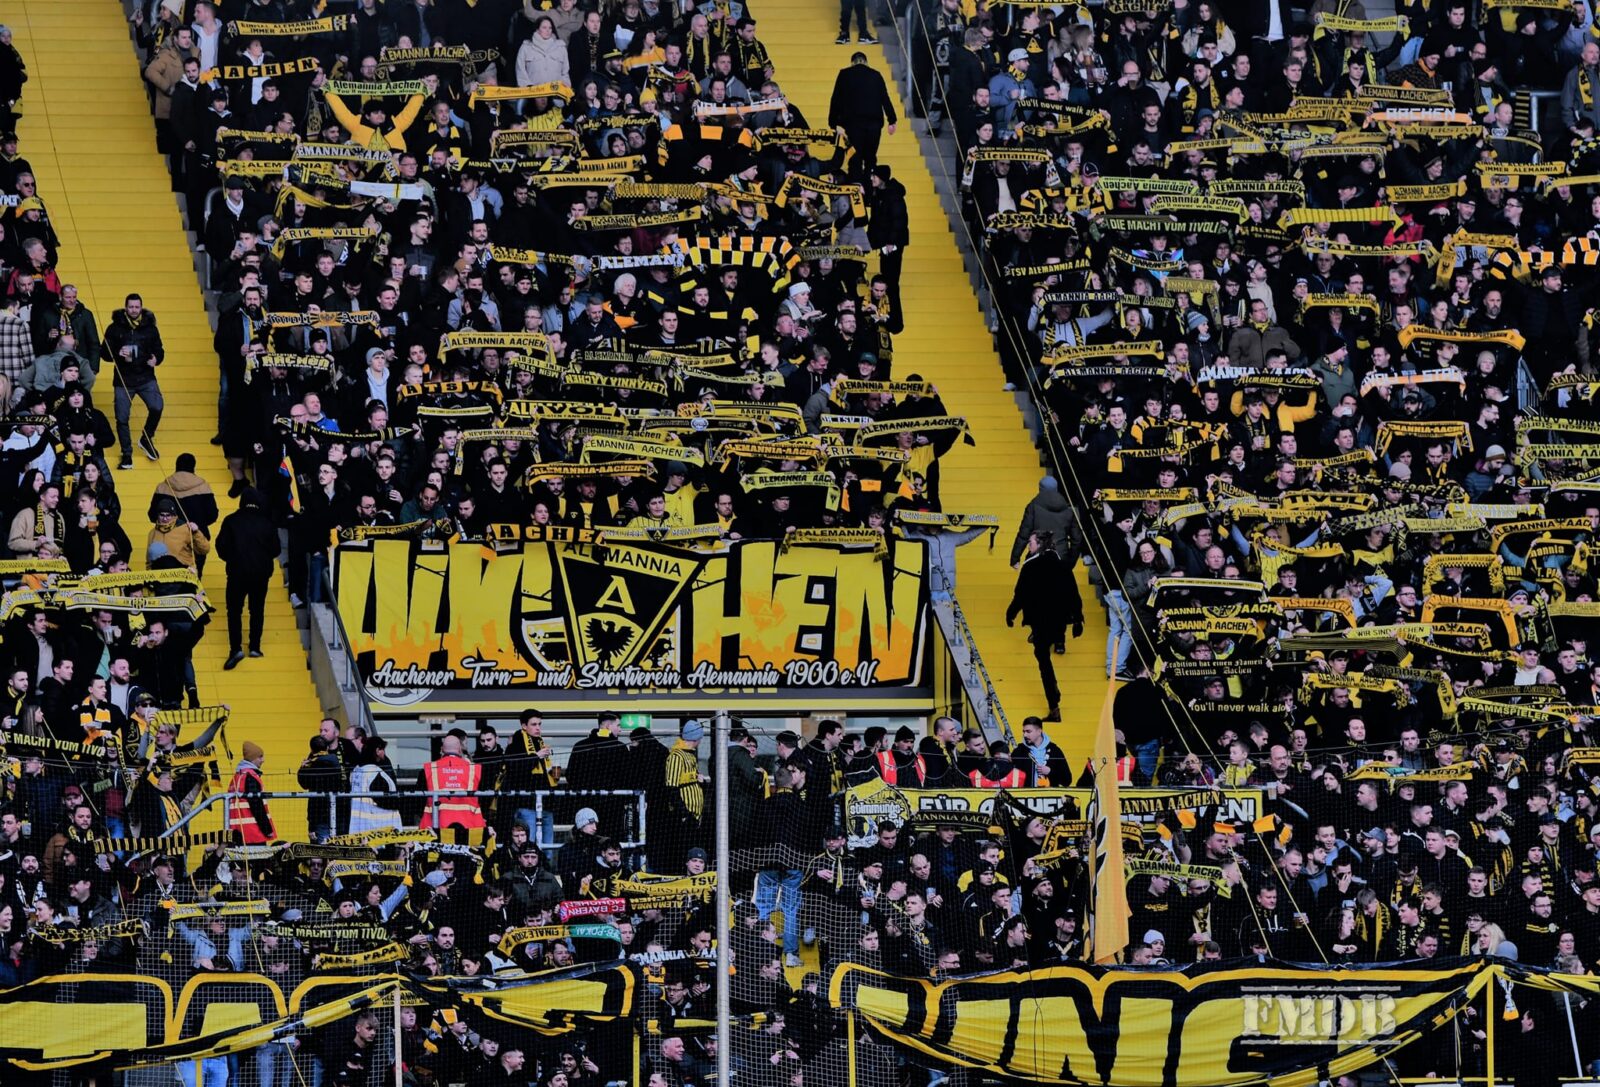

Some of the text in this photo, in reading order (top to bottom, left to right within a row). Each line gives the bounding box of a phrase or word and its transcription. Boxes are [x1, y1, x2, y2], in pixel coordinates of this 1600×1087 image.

[380, 47, 429, 61] LEMANNIA
[333, 79, 422, 92] Alemannia Aachen
[1359, 87, 1429, 101] ALEMANNIA AACHEN
[1040, 101, 1064, 112] never
[1065, 104, 1089, 116] walk
[297, 145, 352, 159] EMANNIA
[247, 161, 323, 171] ALEMNNIA
[1211, 182, 1268, 193] LEMANNIA
[1154, 196, 1241, 209] lemannia Aachen
[1109, 219, 1126, 230] DIE
[332, 227, 372, 238] WILLI
[1009, 266, 1026, 277] TSV
[1026, 262, 1071, 275] ALEMANNIA
[1043, 291, 1089, 302] LEMANNIA
[451, 337, 547, 349] ALEMANNIA AACHEN
[1057, 341, 1151, 358] EMANNIA AACHEN
[565, 372, 667, 396] LEMANNIA AACHEN
[840, 381, 924, 392] LEMANNIA AACHEN
[1550, 374, 1597, 389] LEMANNIA
[495, 429, 514, 437] WALK
[585, 438, 684, 457] EMANNIA AACHEN
[804, 529, 878, 538] ALEMANNIA
[1494, 520, 1555, 539] ALEMANNIA
[563, 544, 682, 577] ALMANNIA
[1165, 607, 1203, 616] MANNIA
[1214, 620, 1248, 631] AACHEN
[1356, 628, 1392, 637] WIR SIND
[1167, 659, 1198, 668] radition
[372, 656, 879, 689] Aachener Turn- und Sportverein Alemannia 1900 e.V.
[1223, 666, 1252, 675] Aachen
[1217, 703, 1245, 712] never
[1248, 702, 1269, 713] walk
[1463, 702, 1550, 721] STAMMSPIELER
[55, 739, 79, 753] VOM
[445, 781, 462, 789] Service
[1168, 790, 1220, 810] AACHEN
[912, 812, 958, 822] MANNIA
[1130, 860, 1182, 873] LEMANNIA
[690, 876, 716, 887] TSV
[566, 902, 626, 916] FC BAYERN
